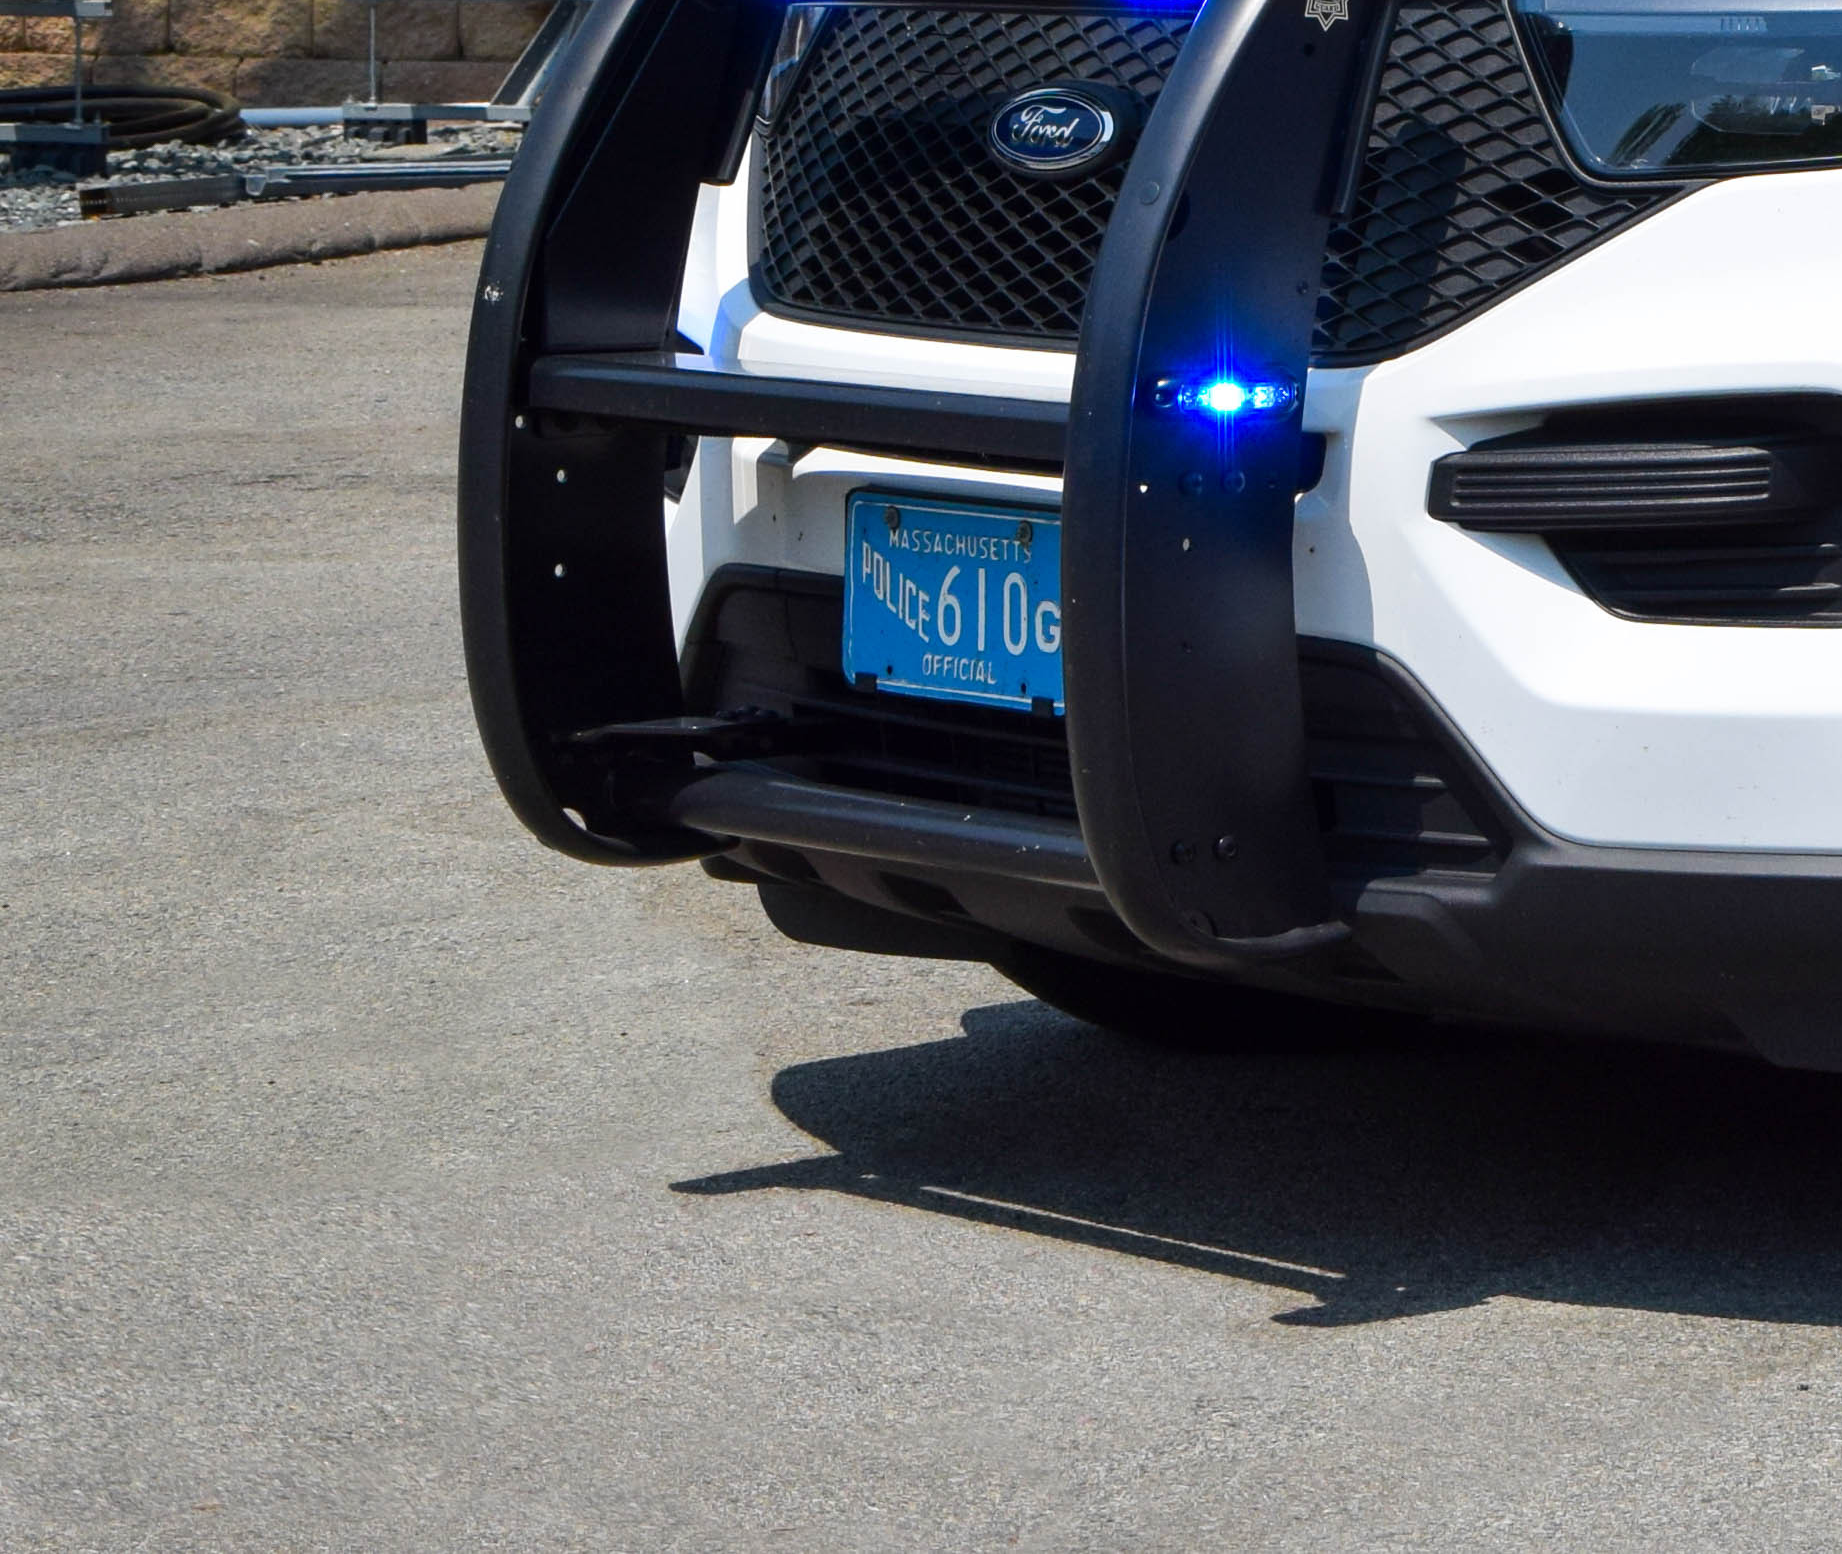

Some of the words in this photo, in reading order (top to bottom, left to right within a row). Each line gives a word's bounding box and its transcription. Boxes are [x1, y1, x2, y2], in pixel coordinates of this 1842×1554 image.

[1011, 104, 1080, 148] Ford
[862, 541, 931, 643] POLICE
[922, 652, 997, 685] OFFICIAL
